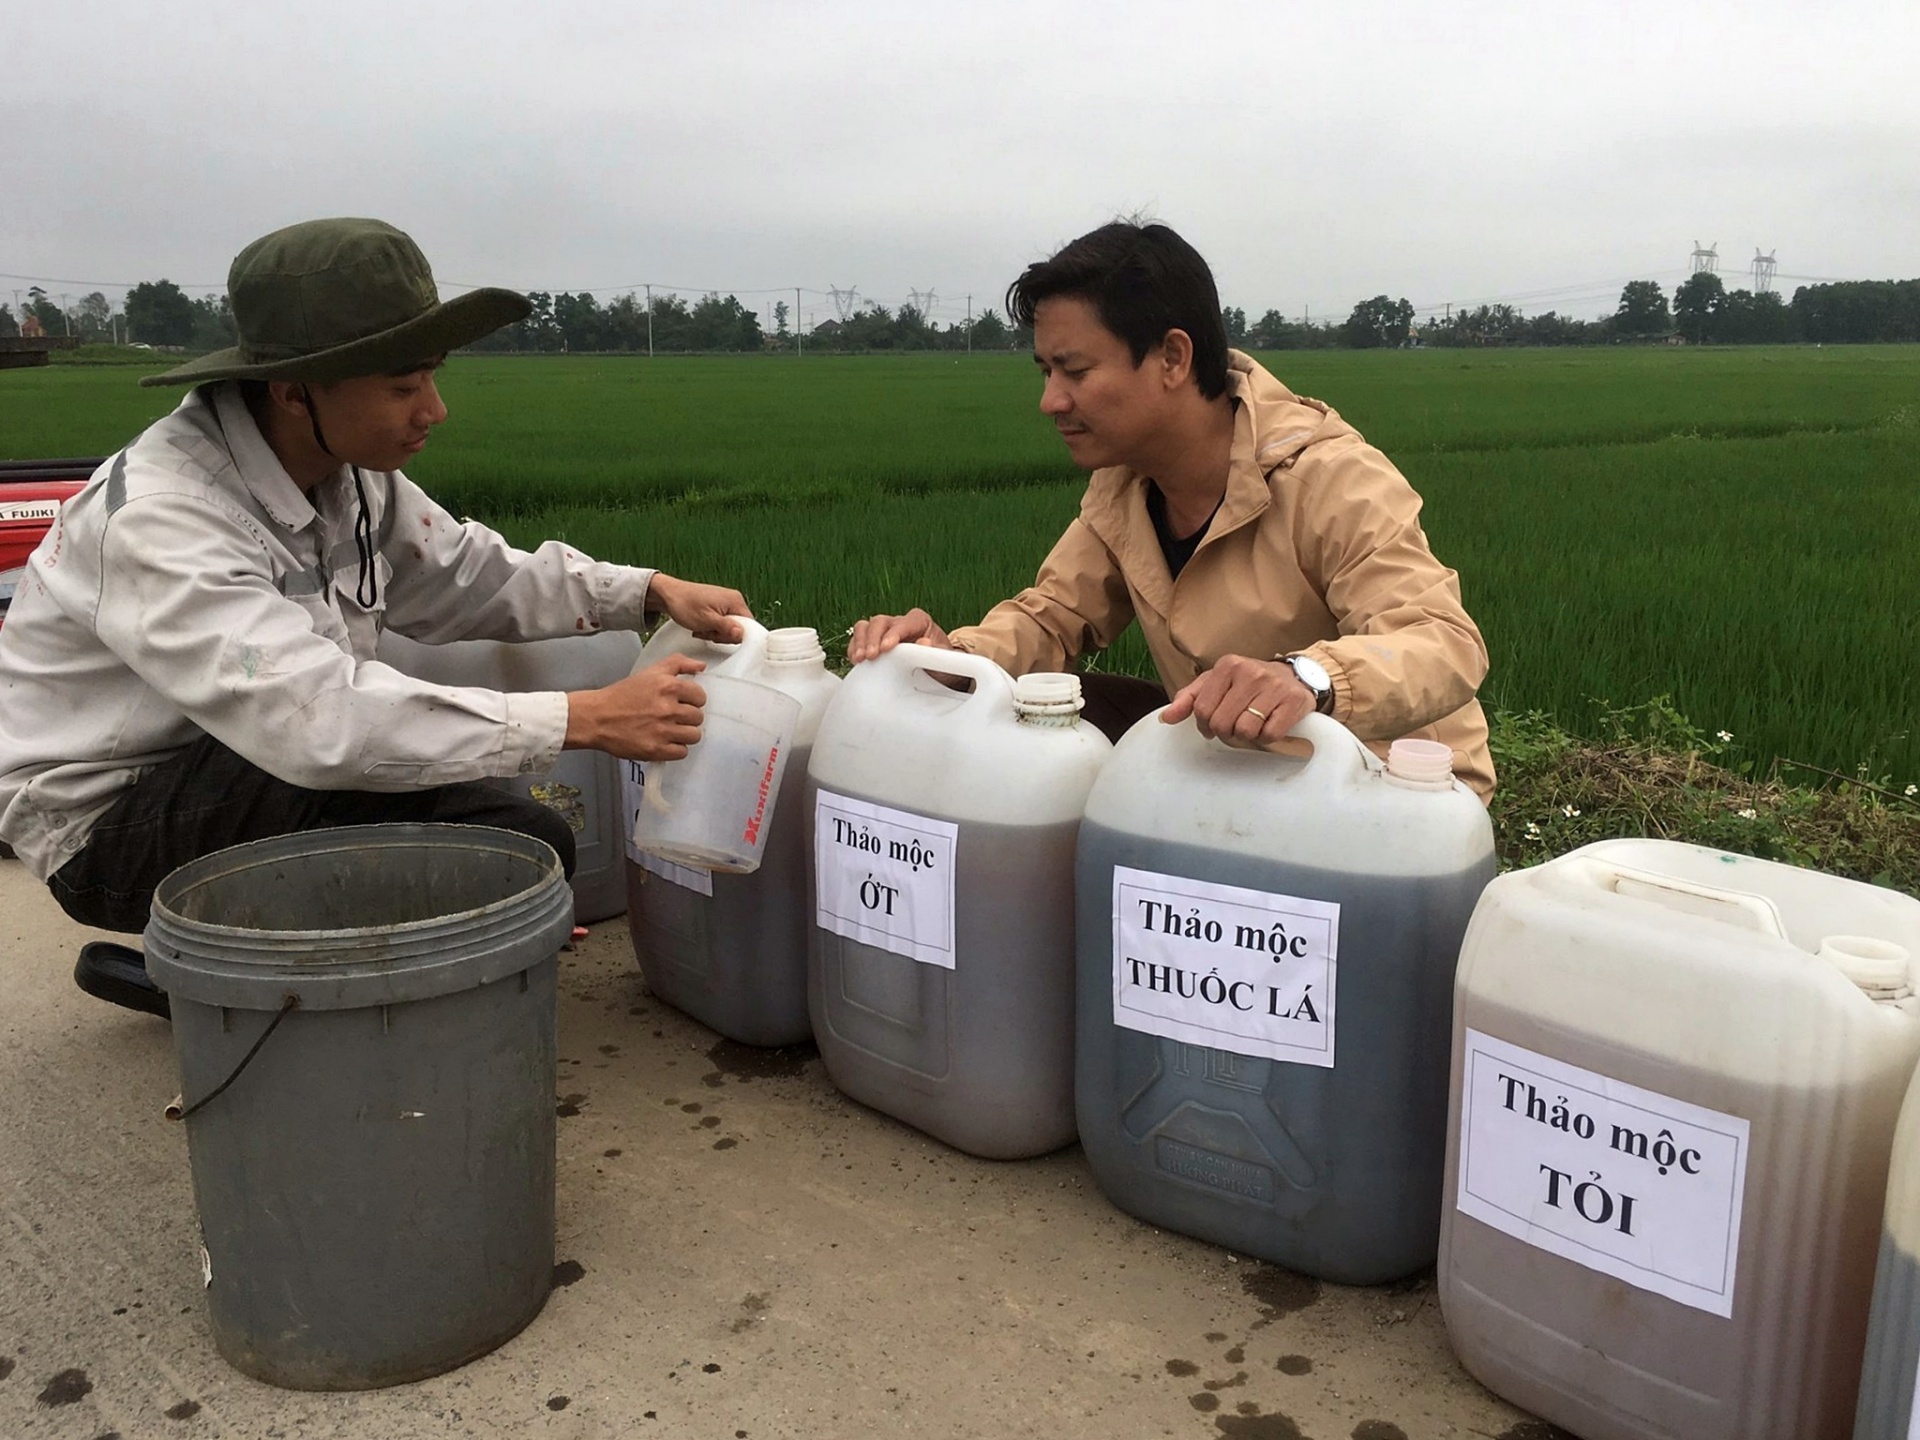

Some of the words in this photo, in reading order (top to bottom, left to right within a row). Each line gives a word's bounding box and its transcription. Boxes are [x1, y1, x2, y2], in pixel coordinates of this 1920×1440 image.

[11, 509, 54, 519] FUJIKI
[832, 817, 881, 855] Thảo
[889, 838, 935, 872] mộc
[859, 872, 899, 916] ỚT
[1138, 899, 1223, 943] Thảo
[1234, 923, 1307, 964] mộc
[1126, 957, 1254, 1011] THUỐC
[1267, 984, 1321, 1023] LÁ
[1498, 1073, 1595, 1139] Thảo
[1609, 1125, 1701, 1175] mộc
[1539, 1163, 1638, 1237] TỎI
